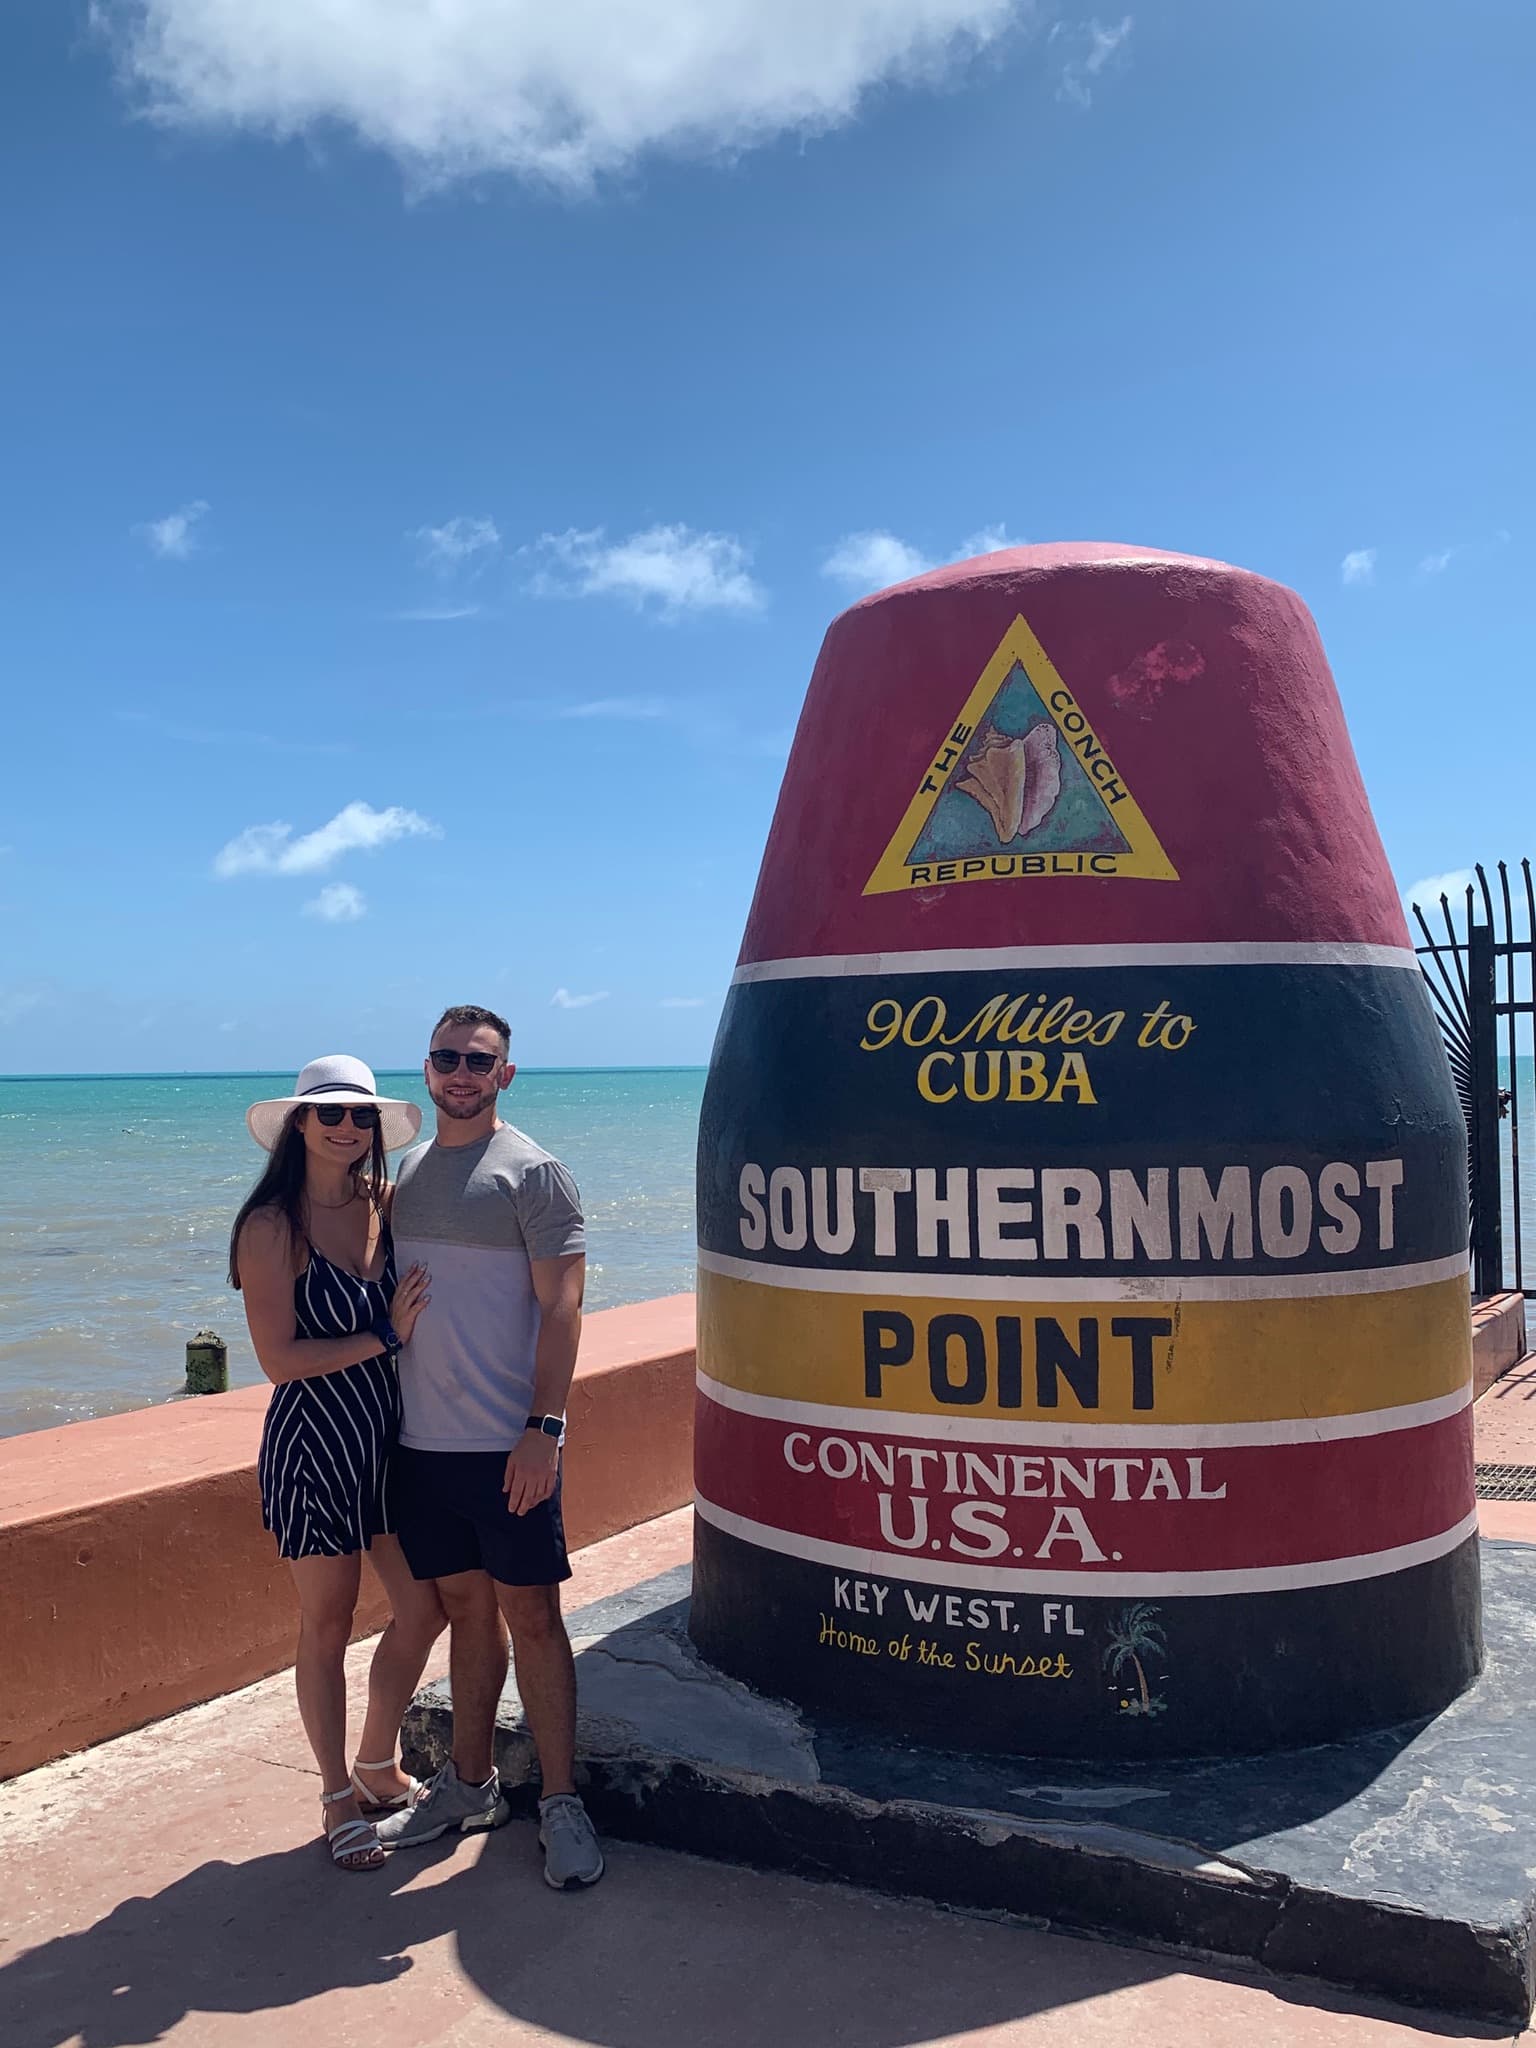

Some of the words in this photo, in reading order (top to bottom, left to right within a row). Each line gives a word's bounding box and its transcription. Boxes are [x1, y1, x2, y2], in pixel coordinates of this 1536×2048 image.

[920, 723, 972, 794] THE
[1050, 690, 1127, 805] CONCH
[910, 855, 1117, 885] REPUBLIC
[859, 995, 947, 1051] 90
[939, 993, 1125, 1045] Miles
[1137, 1000, 1198, 1050] to
[916, 1050, 1099, 1105] CUBA
[739, 1158, 1403, 1261] SOUTHERNMOST
[862, 1309, 1172, 1410] POINT
[783, 1431, 1227, 1501] CONTINENTAL
[877, 1492, 1123, 1563] U.S.A.
[834, 1576, 889, 1616] KEY
[904, 1589, 1020, 1633] WEST,
[1042, 1602, 1085, 1636] FL
[819, 1612, 880, 1655] Home
[888, 1633, 911, 1660] of
[916, 1640, 956, 1668] the
[965, 1642, 1074, 1679] Sunset
